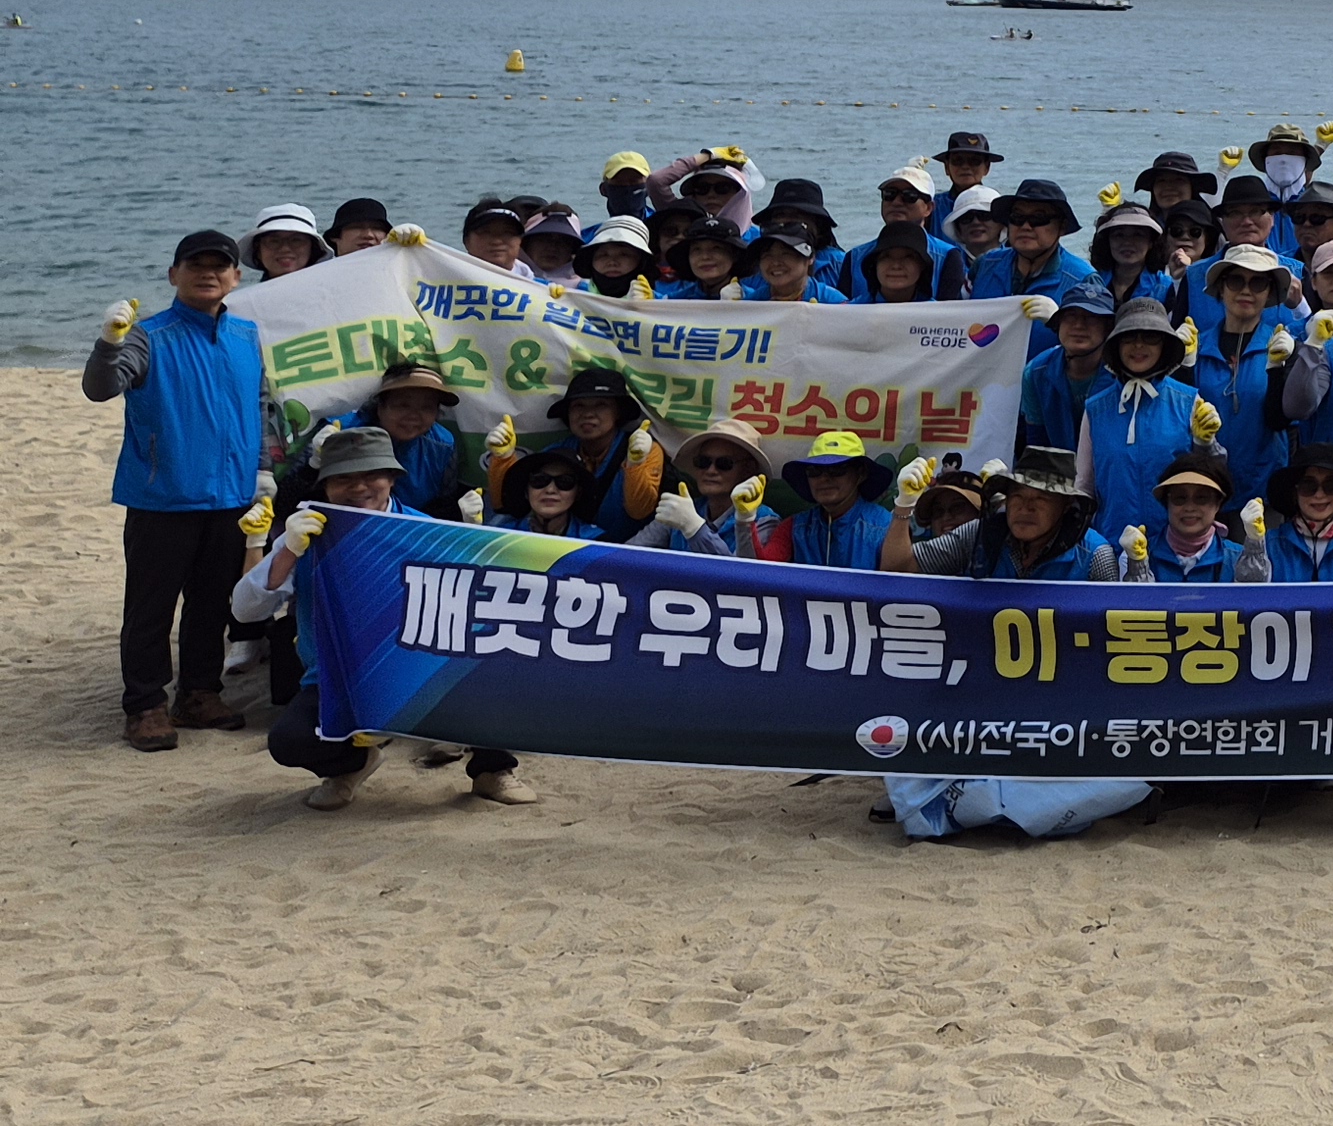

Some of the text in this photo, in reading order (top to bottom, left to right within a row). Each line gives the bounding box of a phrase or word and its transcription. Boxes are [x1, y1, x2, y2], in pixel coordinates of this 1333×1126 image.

[415, 280, 532, 321] 깨끗한
[651, 323, 772, 365] 만들기!
[909, 325, 965, 336] BIG HEART
[920, 335, 968, 349] GEOJE
[505, 339, 550, 391] &
[731, 379, 900, 442] 청소의
[920, 390, 978, 445] 날
[400, 564, 628, 662] 깨끗한
[638, 591, 784, 672] 우리
[806, 600, 968, 686] 마을,
